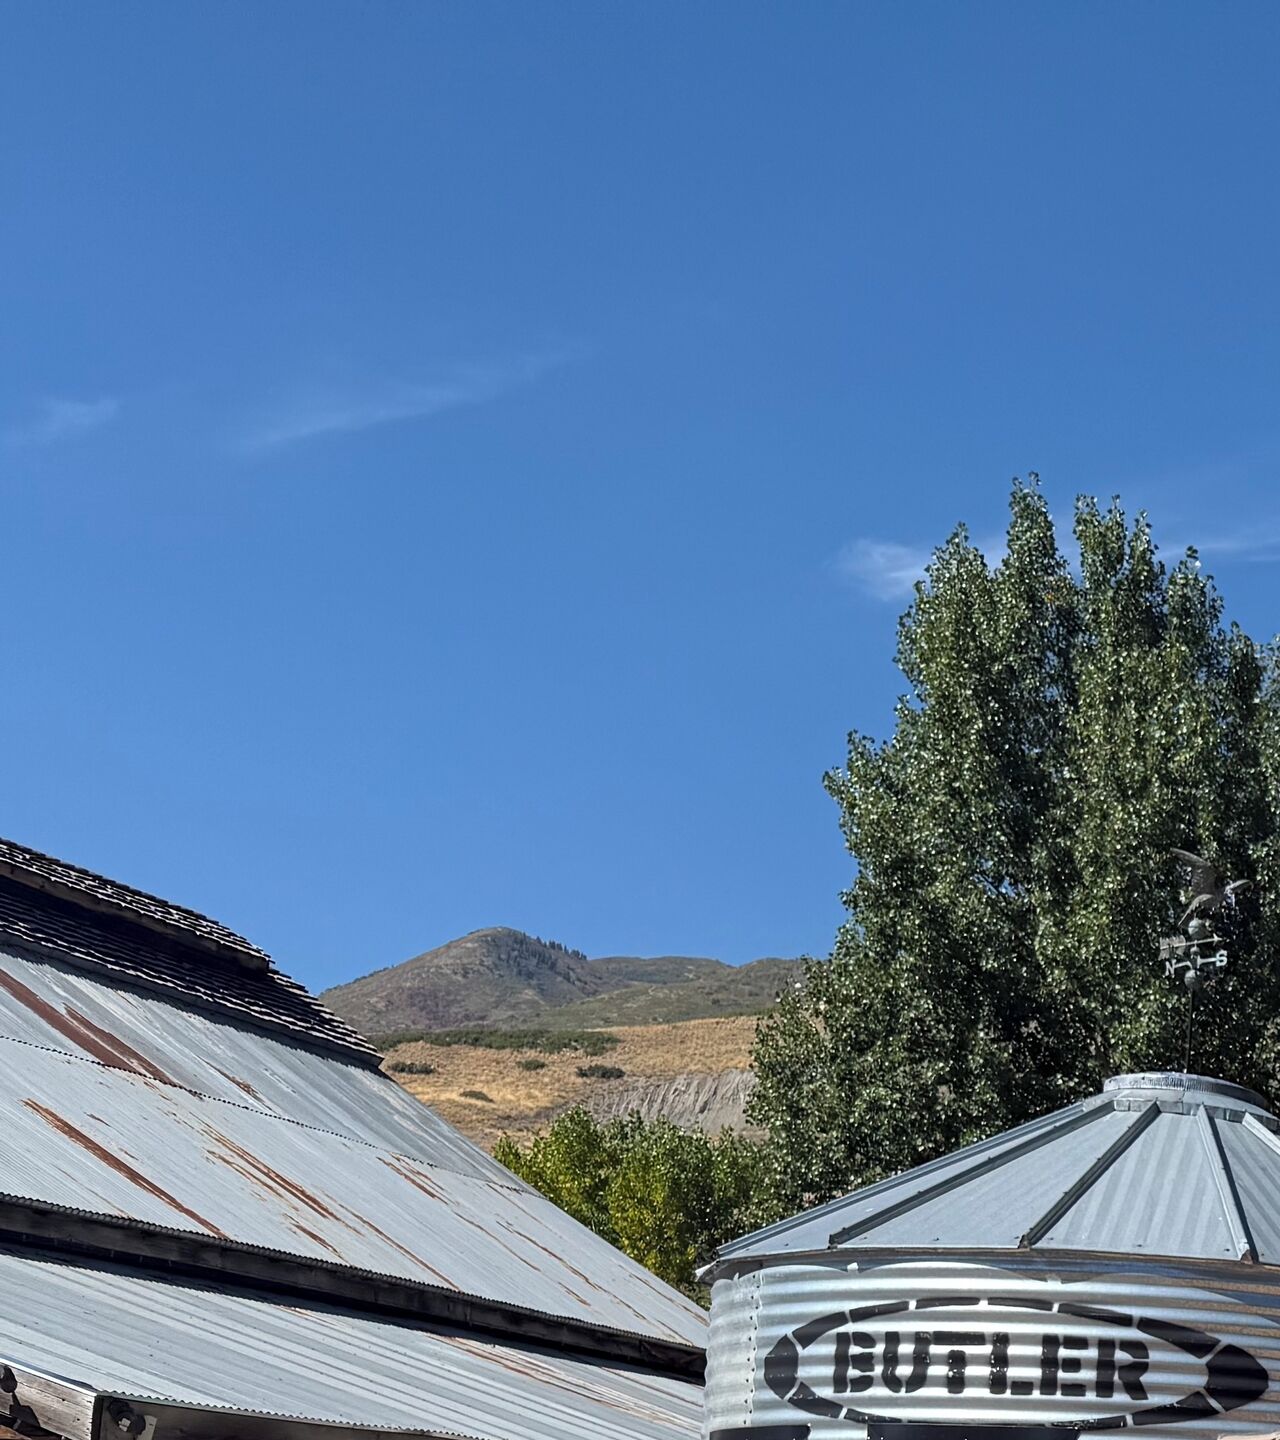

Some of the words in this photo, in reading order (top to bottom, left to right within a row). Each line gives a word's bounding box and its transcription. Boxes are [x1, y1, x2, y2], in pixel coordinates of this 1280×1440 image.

[1215, 950, 1228, 967] S
[1165, 960, 1176, 976] N
[834, 1330, 1149, 1400] BUTLER
